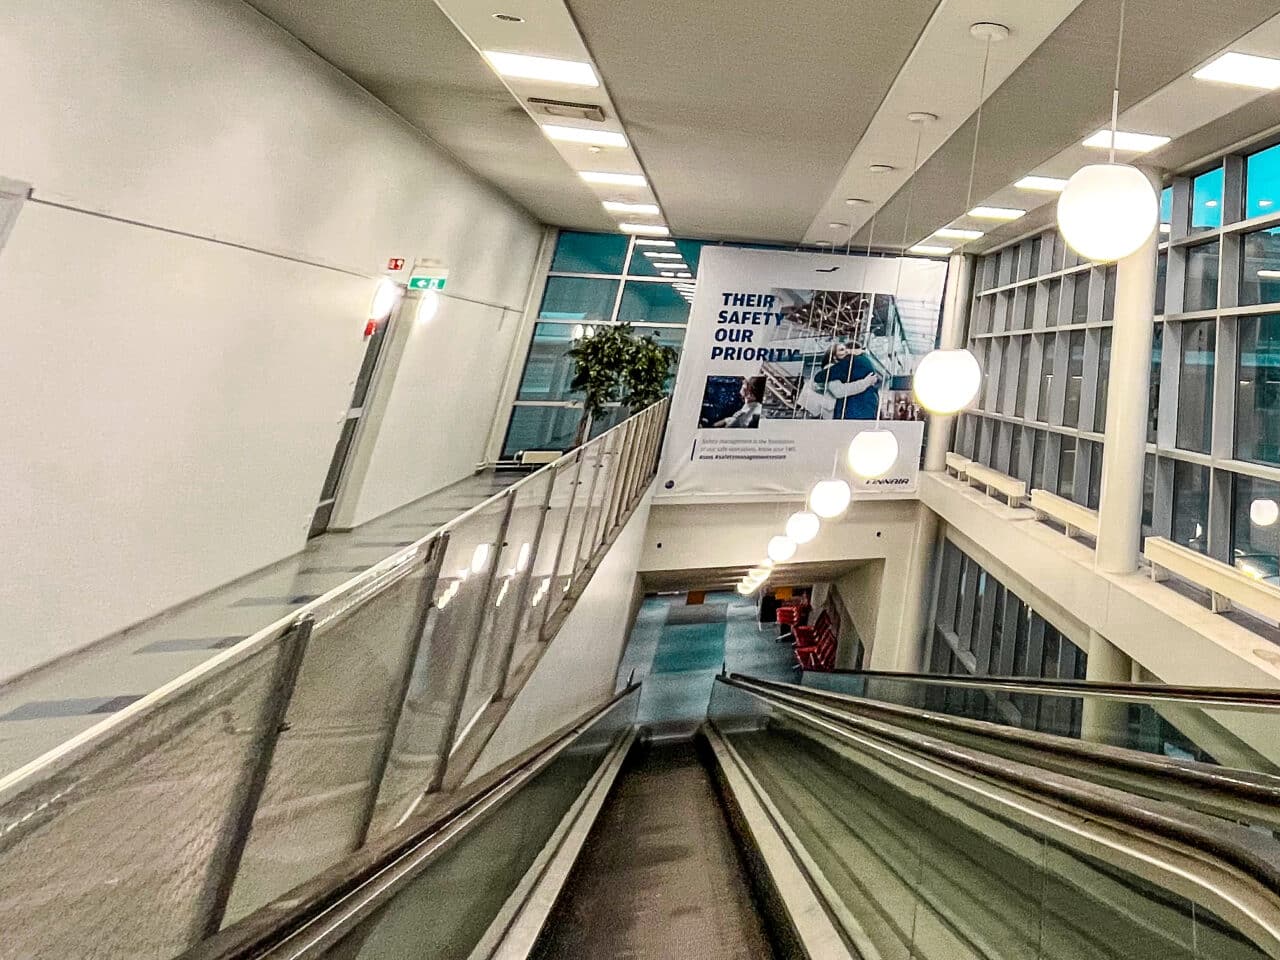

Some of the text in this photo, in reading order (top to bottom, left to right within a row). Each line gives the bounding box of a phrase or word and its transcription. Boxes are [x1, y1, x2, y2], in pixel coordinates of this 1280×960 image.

[722, 293, 775, 307] THEIR
[717, 310, 785, 326] SAFETY
[714, 328, 754, 343] OUR
[711, 346, 800, 362] PRIORITY
